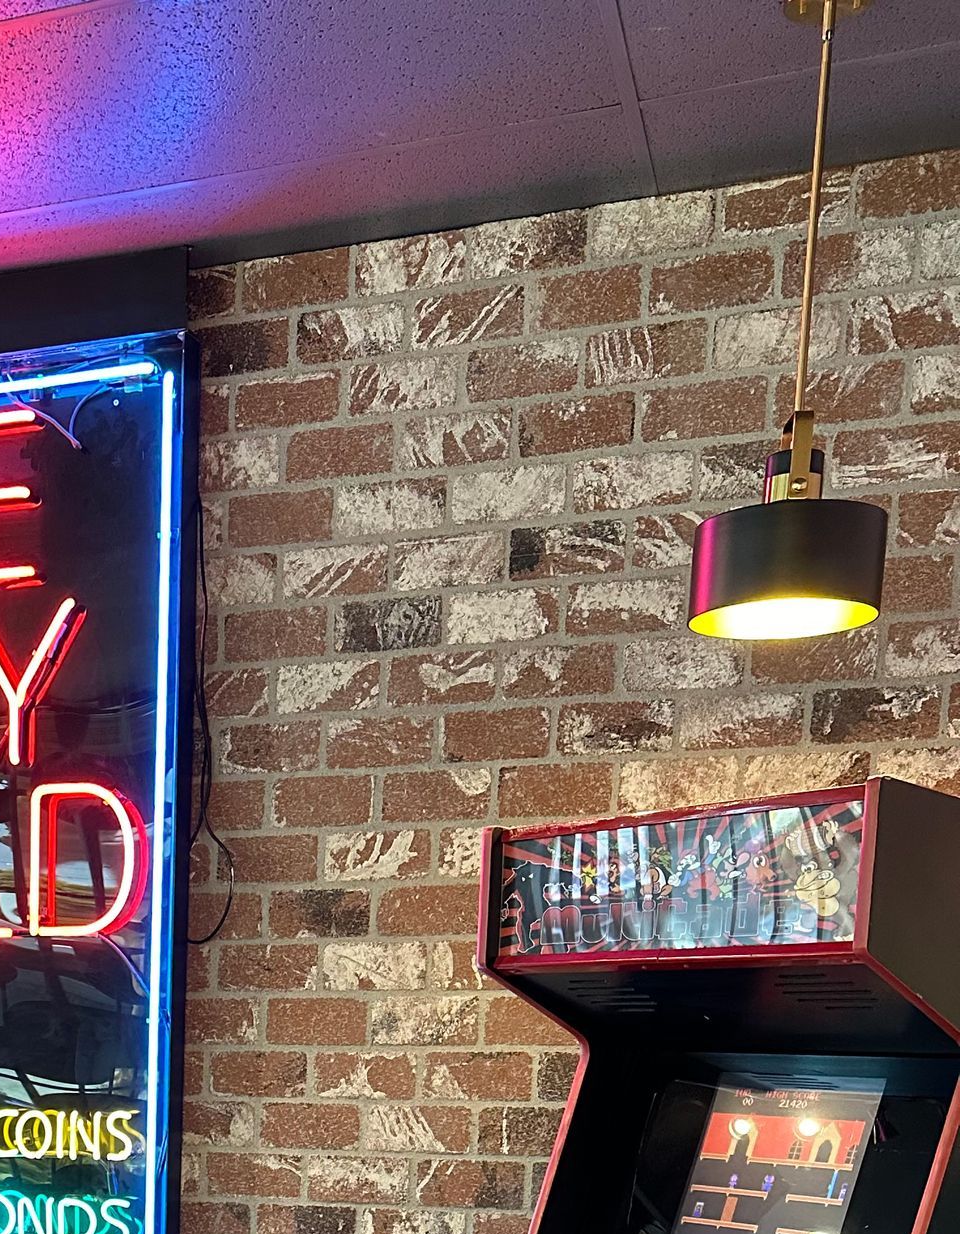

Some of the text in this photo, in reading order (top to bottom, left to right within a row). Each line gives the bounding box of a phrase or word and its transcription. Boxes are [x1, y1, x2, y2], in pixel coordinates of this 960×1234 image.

[765, 1090, 788, 1100] HIGH
[792, 1091, 821, 1101] SCORE
[778, 1099, 808, 1109] 21420
